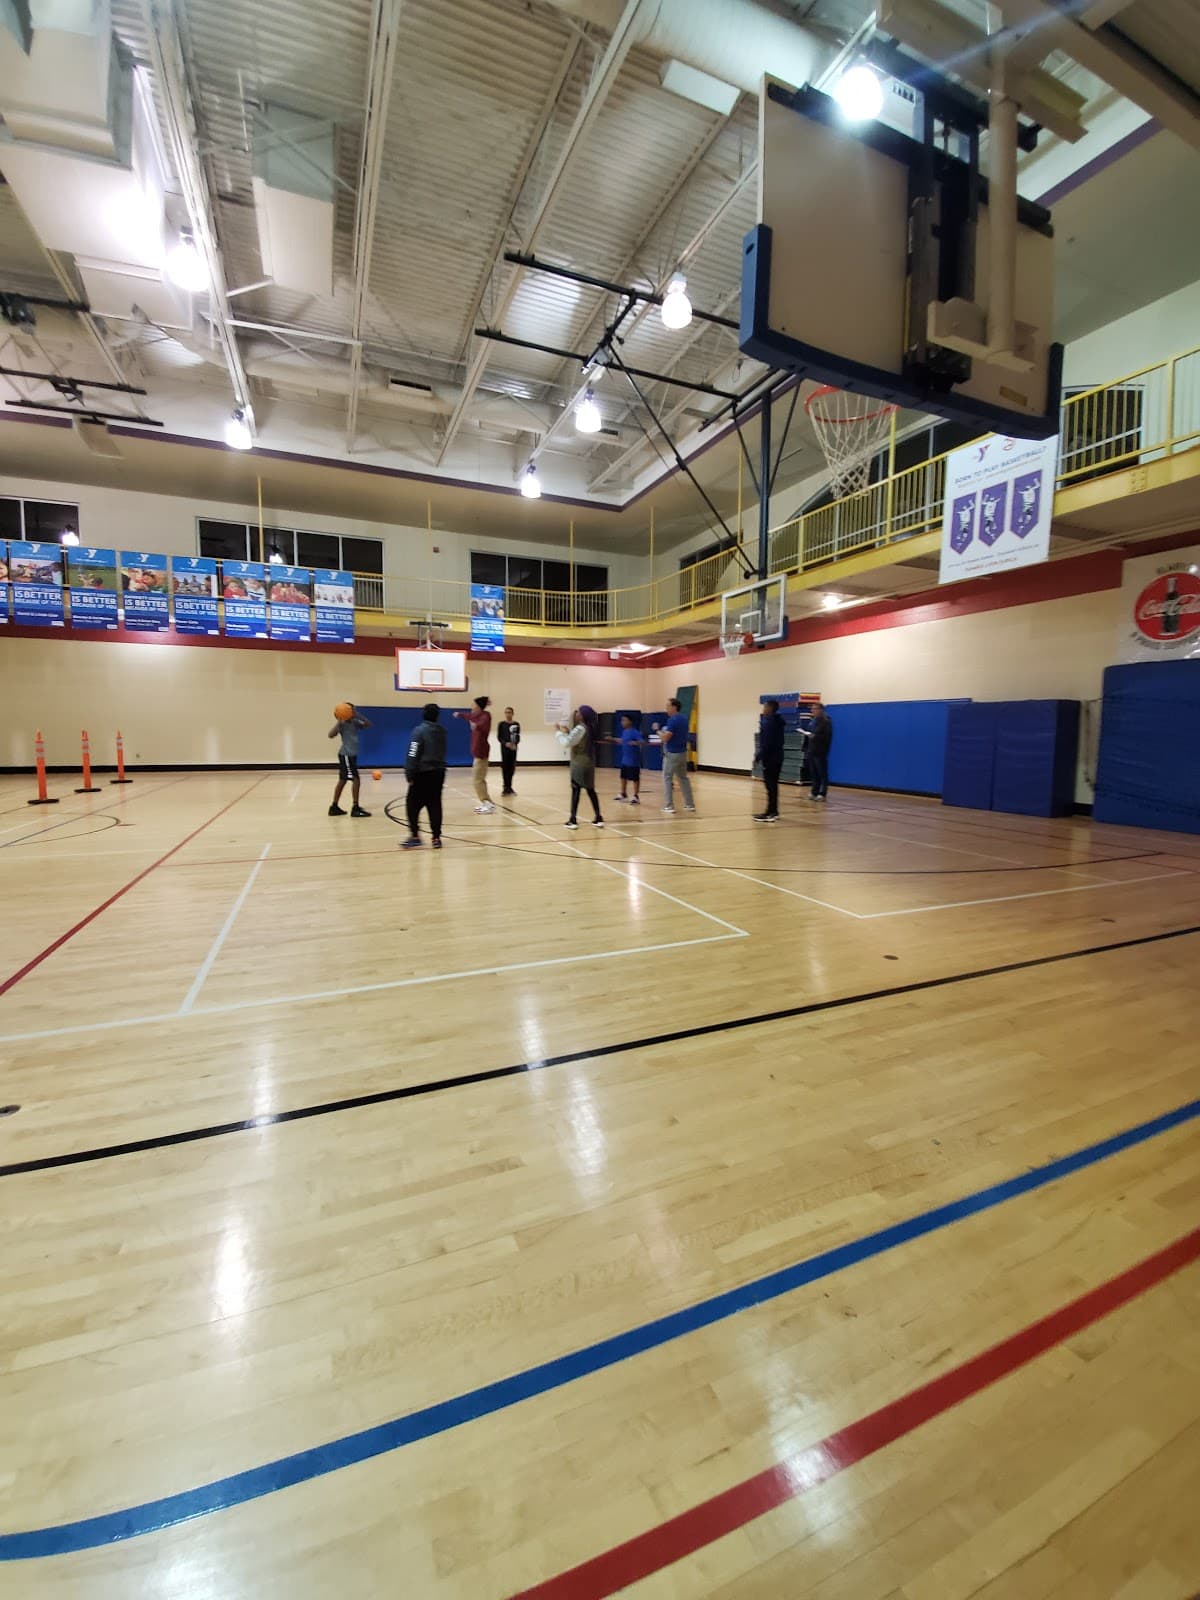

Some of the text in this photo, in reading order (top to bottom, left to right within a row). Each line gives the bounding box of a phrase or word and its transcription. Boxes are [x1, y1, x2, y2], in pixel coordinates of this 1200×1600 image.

[15, 590, 23, 598] IS
[24, 591, 62, 600] BETTER
[83, 596, 116, 604] BETTER
[135, 599, 167, 607] BETTER
